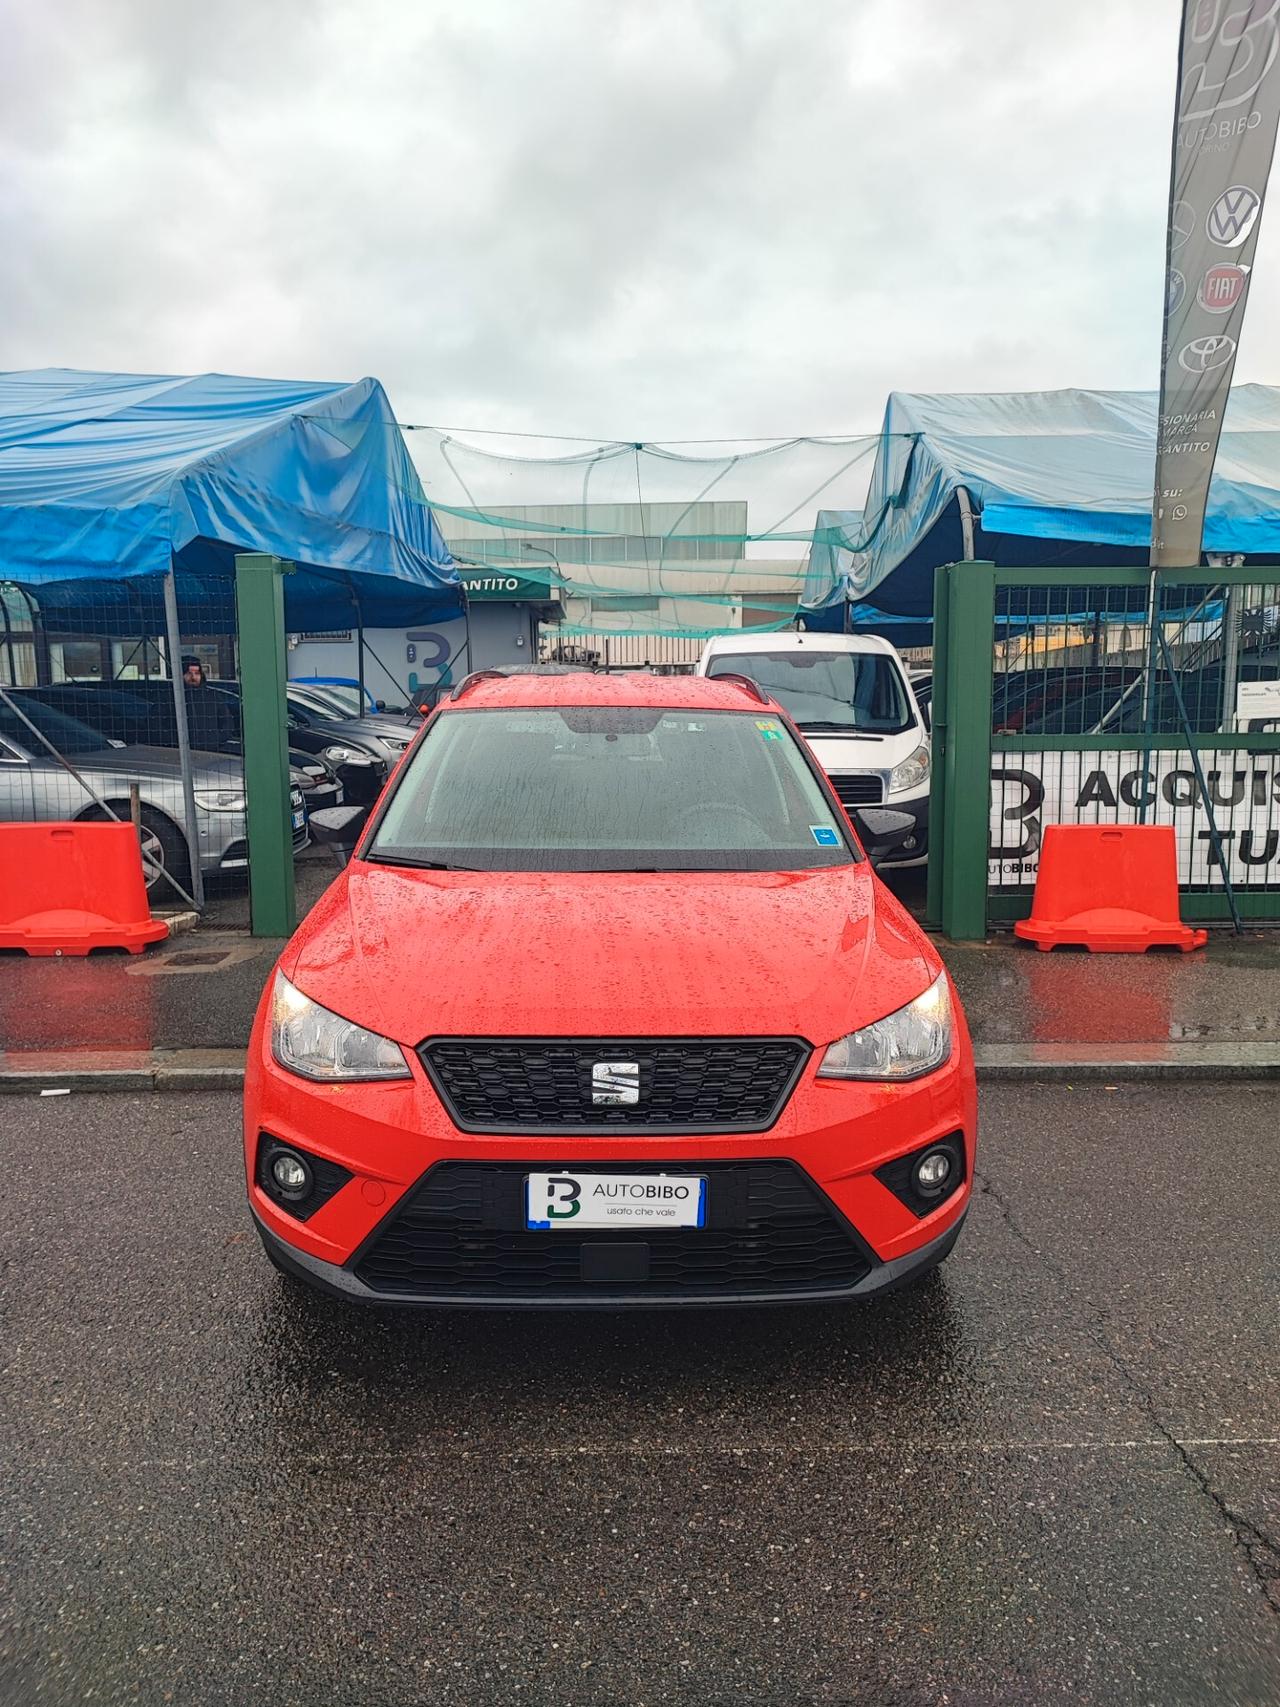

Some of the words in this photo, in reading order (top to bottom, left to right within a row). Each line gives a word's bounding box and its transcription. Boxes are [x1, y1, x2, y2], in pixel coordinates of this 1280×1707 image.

[1206, 277, 1238, 300] FIAT
[1162, 488, 1183, 498] su:
[1075, 769, 1280, 809] ACQUI
[1197, 829, 1280, 865] TU
[592, 1183, 690, 1200] AUTOBIBO
[606, 1207, 633, 1216] usato
[634, 1206, 654, 1217] che
[655, 1208, 677, 1217] vale
